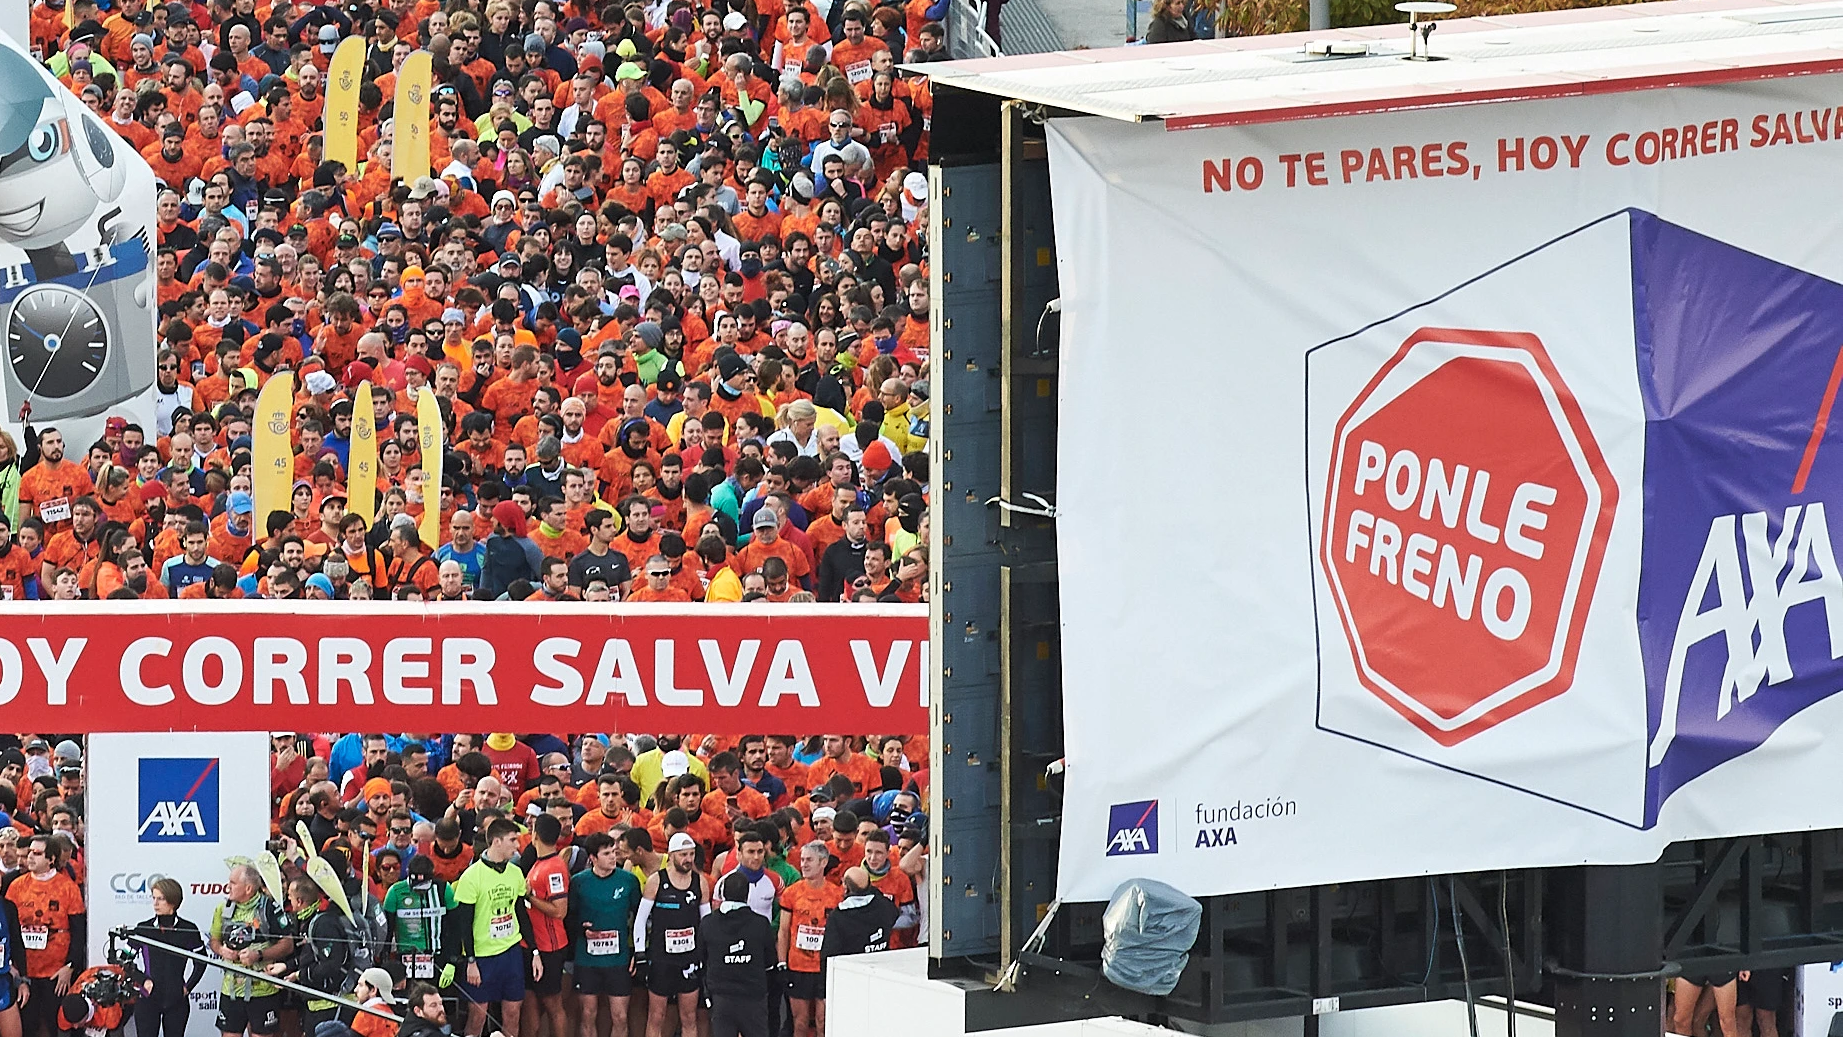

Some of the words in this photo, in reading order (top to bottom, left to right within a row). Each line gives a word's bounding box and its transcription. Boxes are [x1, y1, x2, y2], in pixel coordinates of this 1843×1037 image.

[1202, 154, 1263, 193] NO
[1280, 151, 1328, 190] TE
[1341, 140, 1482, 185] PARES,
[1498, 135, 1590, 173] HOY
[1606, 118, 1738, 166] CORRER
[274, 458, 287, 469] 45
[1355, 440, 1557, 561] PONLE
[1344, 511, 1533, 642] FRENO
[119, 636, 498, 706] CORRER
[531, 637, 821, 707] SALVA
[138, 801, 206, 836] AXA
[1194, 795, 1297, 824] fundación
[1106, 826, 1155, 854] AXA
[1194, 827, 1237, 848] AXA
[190, 883, 231, 895] TUDO
[724, 954, 752, 964] STAFF
[865, 941, 888, 953] STAFF
[190, 990, 217, 1003] sport
